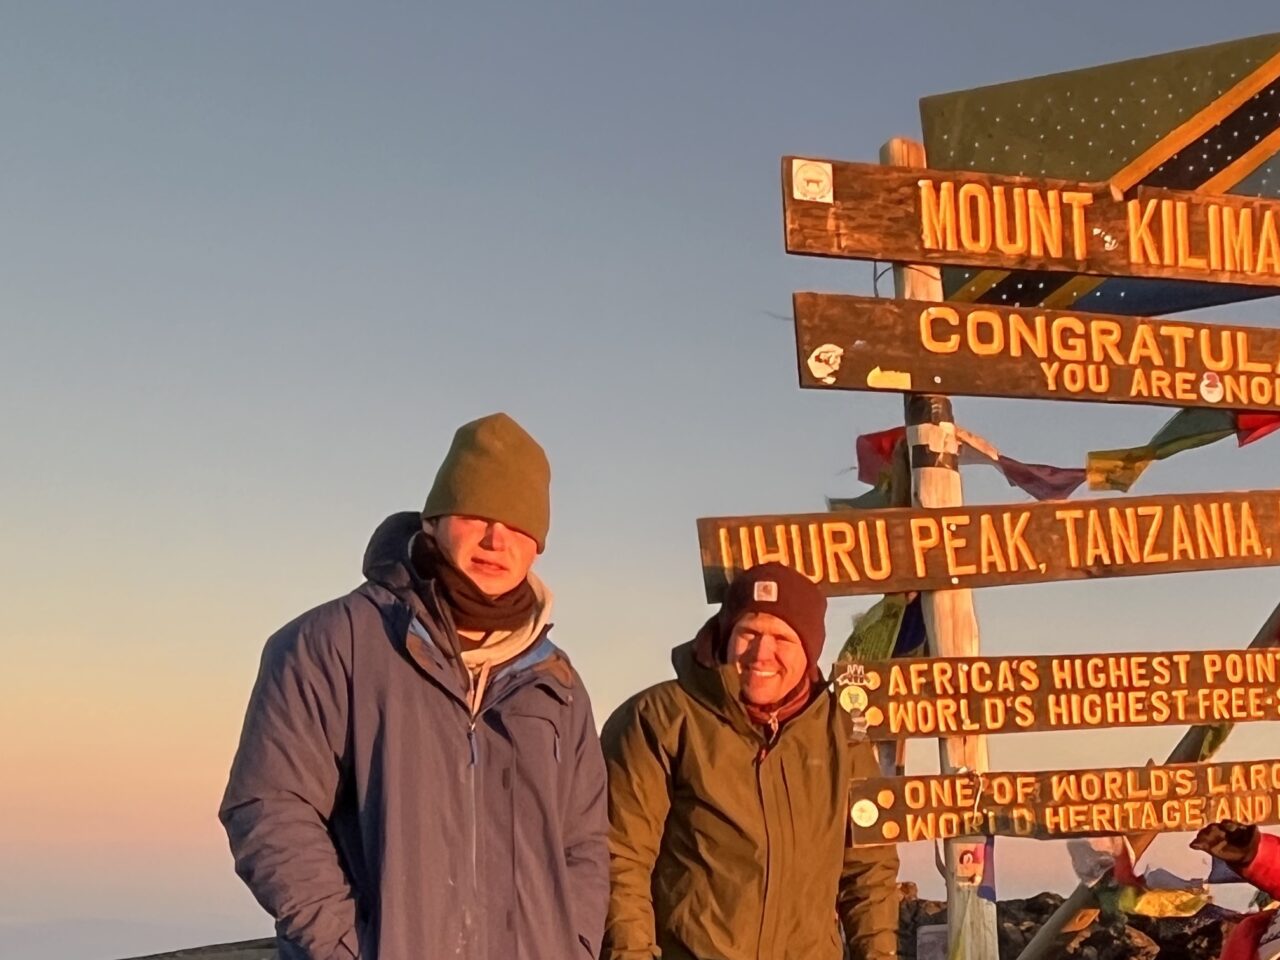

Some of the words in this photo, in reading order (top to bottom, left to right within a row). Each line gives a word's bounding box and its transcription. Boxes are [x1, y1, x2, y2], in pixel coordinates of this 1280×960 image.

[918, 179, 1093, 260] MOUNT
[1040, 361, 1109, 393] YOU
[1130, 368, 1198, 400] ARE
[719, 519, 892, 584] UHURU
[911, 510, 1047, 578] PEAK,
[1055, 501, 1272, 569] TANZANIA,
[888, 660, 1039, 696] AFRICA'S
[1052, 654, 1191, 690] HIGHEST
[888, 696, 1035, 734] WORLD'S
[1048, 690, 1189, 726] HIGHEST
[904, 778, 975, 809] ONE
[991, 777, 1036, 805] OF
[1051, 769, 1195, 803] WORLD'S
[1045, 798, 1203, 834] HERITAGE
[1215, 794, 1272, 823] AND
